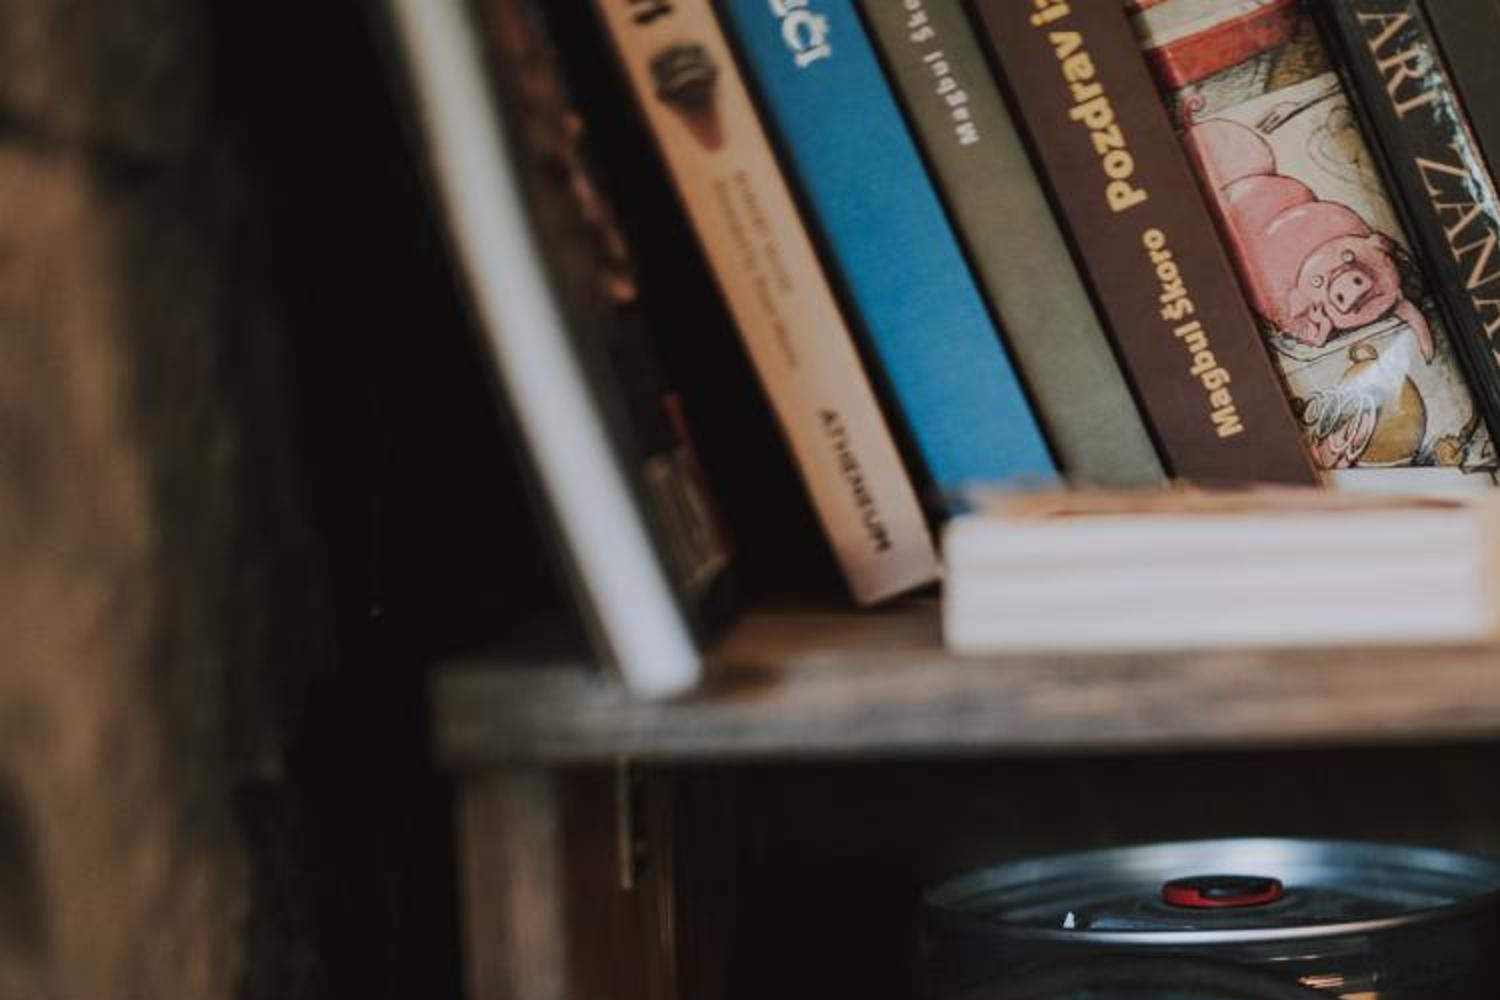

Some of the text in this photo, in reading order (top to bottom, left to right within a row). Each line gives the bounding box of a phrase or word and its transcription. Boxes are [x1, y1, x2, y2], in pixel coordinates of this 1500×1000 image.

[922, 50, 980, 145] Magbul
[1030, 0, 1244, 438] Magbul Škoro Pozdrav i
